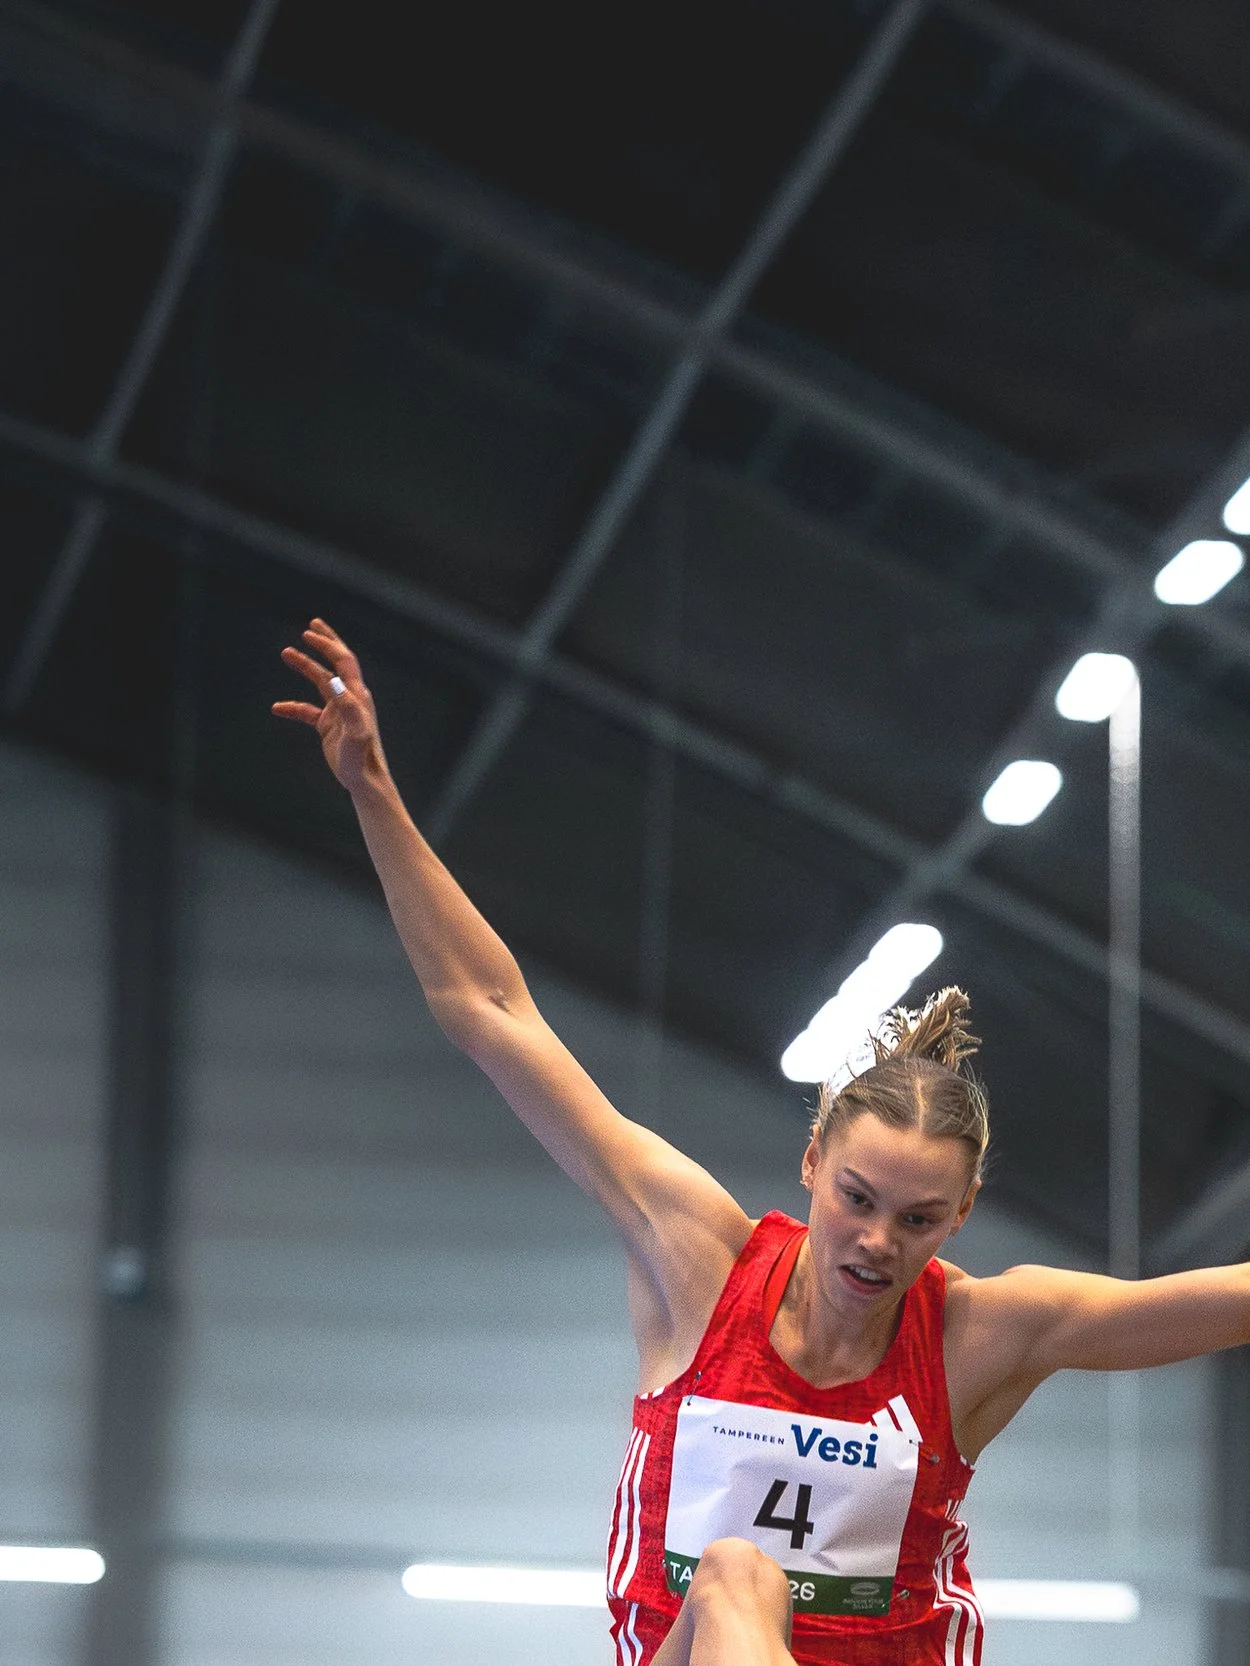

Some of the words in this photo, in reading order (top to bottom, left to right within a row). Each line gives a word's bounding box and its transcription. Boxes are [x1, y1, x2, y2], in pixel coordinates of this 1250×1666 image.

[713, 1425, 786, 1446] TAMPEREEN
[791, 1424, 879, 1469] Vesi
[753, 1479, 814, 1550] 4
[669, 1560, 693, 1584] TA
[788, 1579, 816, 1601] 26
